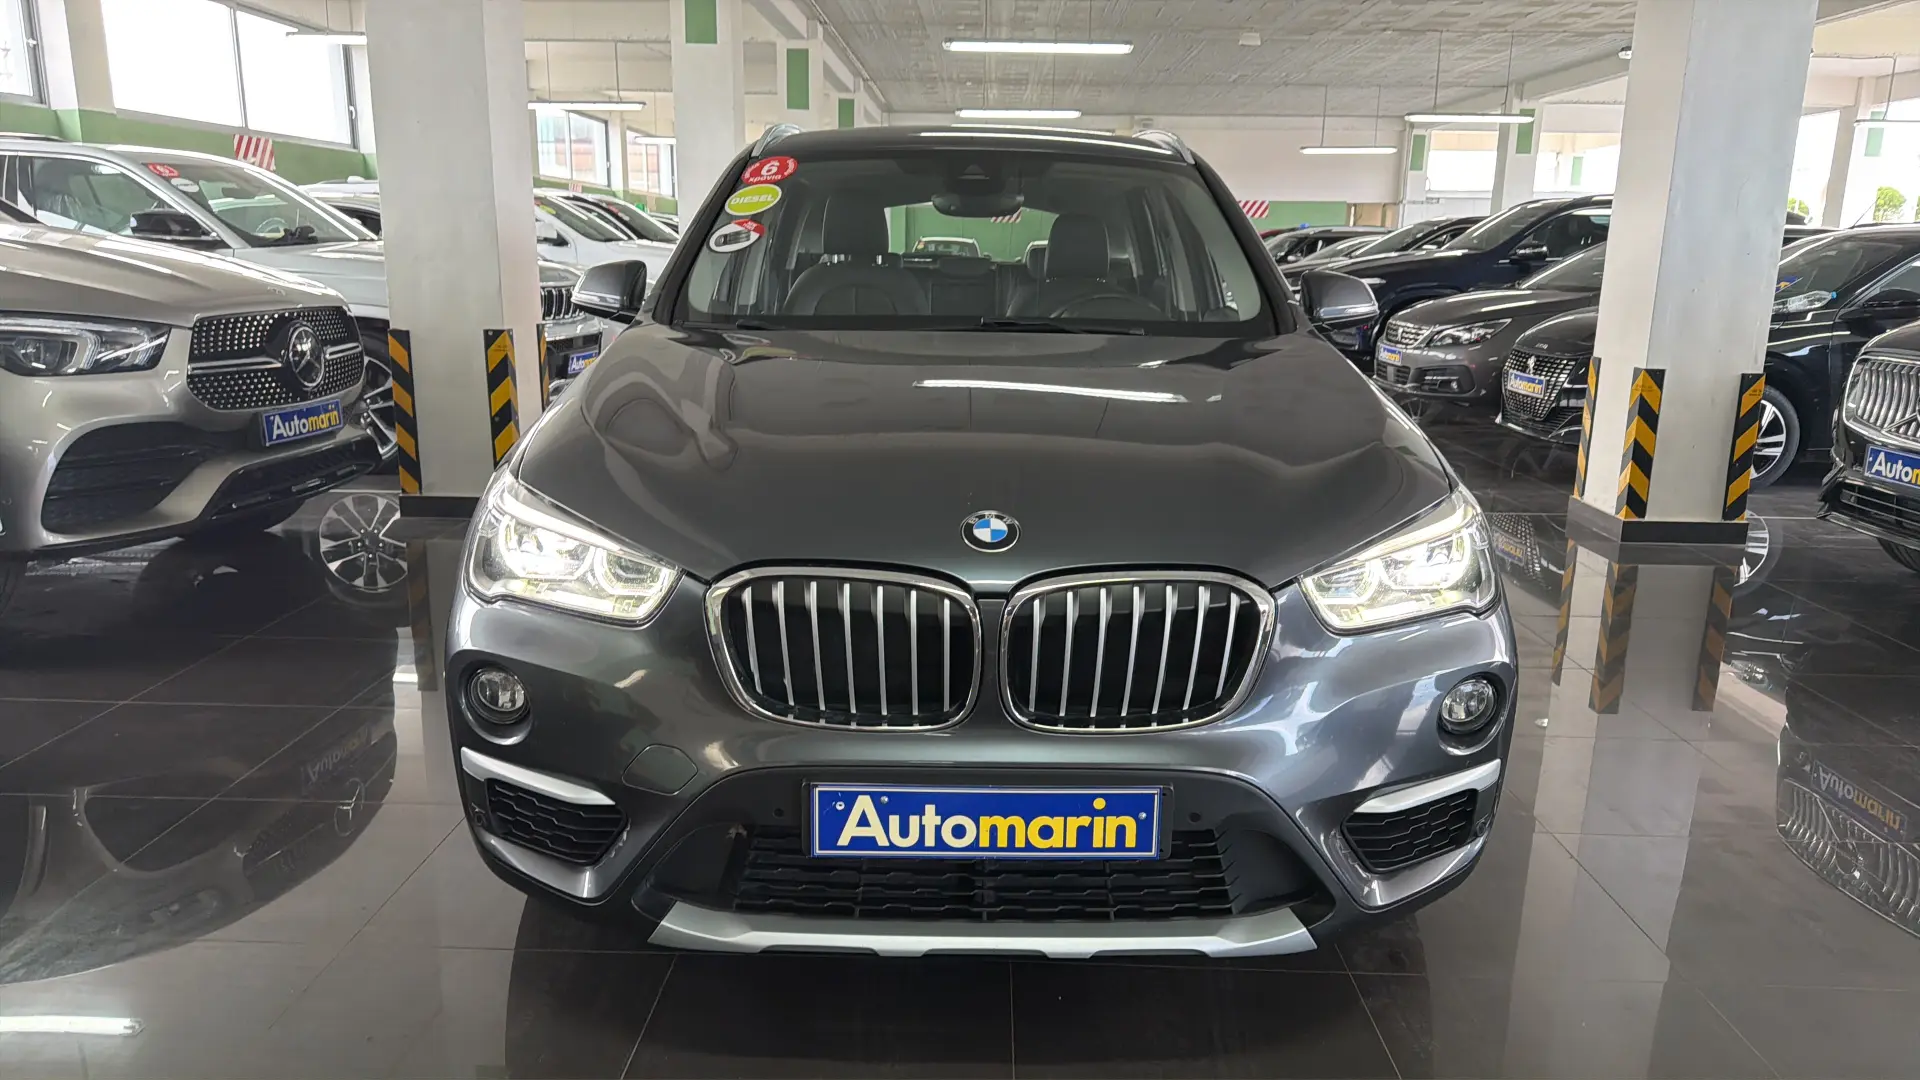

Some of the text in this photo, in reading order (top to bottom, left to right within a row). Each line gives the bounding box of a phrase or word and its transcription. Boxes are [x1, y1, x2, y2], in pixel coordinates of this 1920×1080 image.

[761, 161, 780, 176] 6
[730, 194, 775, 205] DIESEL
[272, 405, 340, 440] Automarin
[967, 513, 1015, 525] BMW
[836, 794, 1138, 850] Automarin
